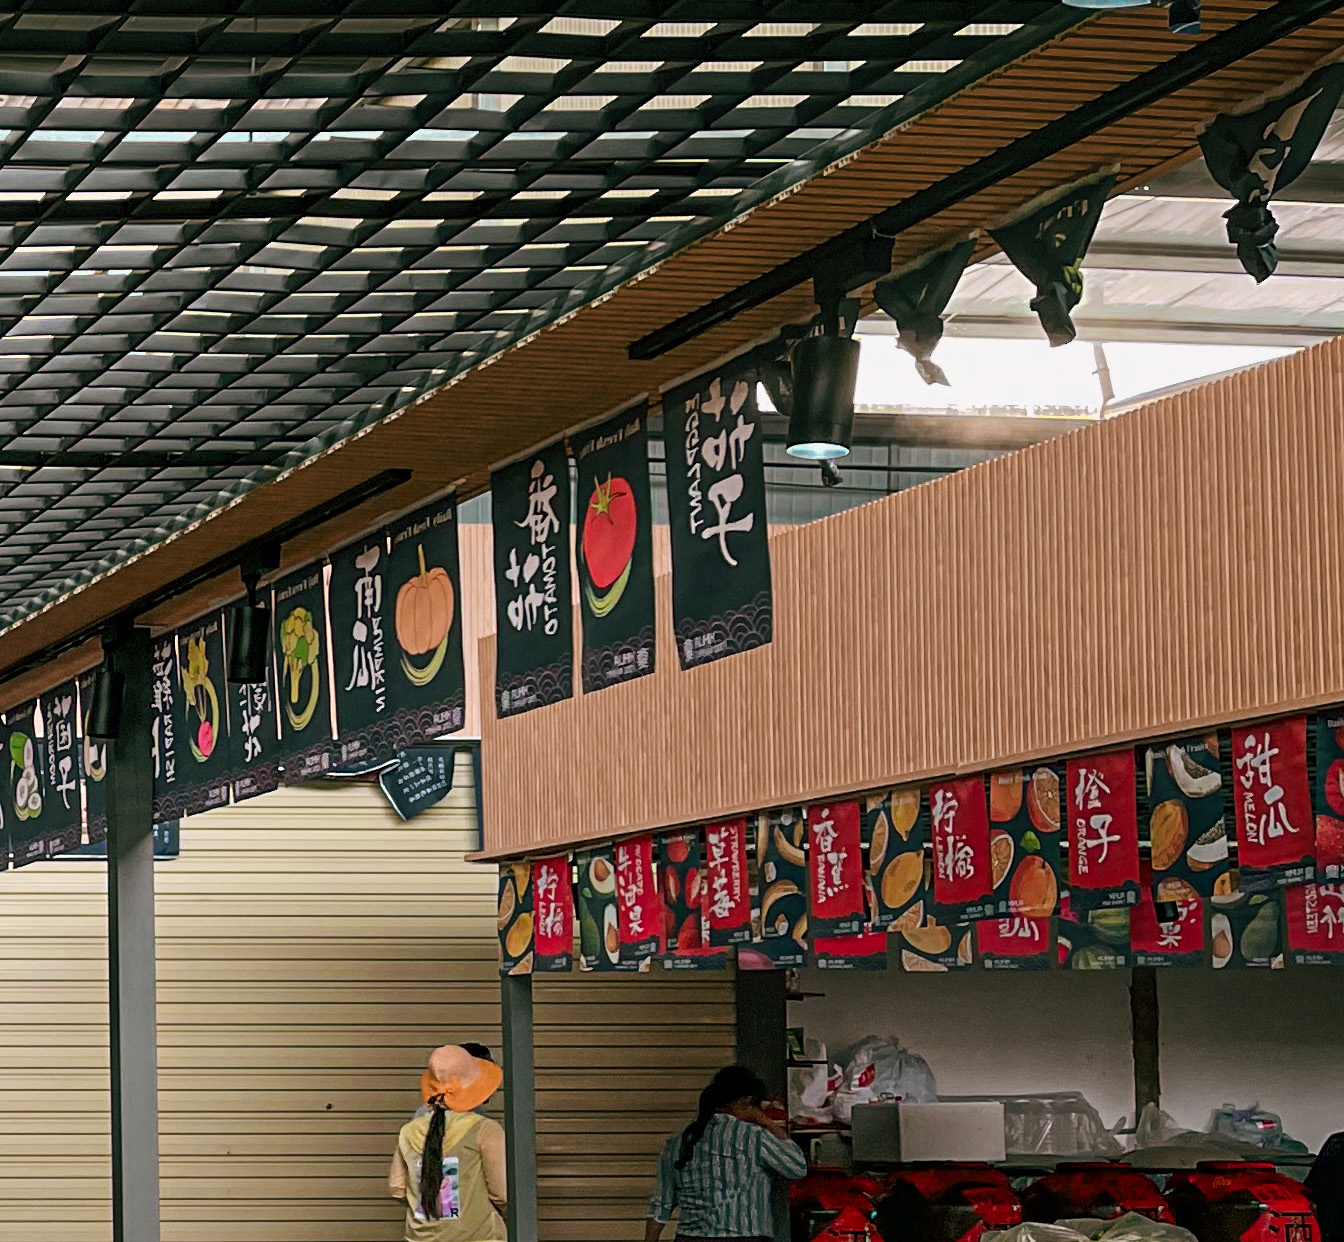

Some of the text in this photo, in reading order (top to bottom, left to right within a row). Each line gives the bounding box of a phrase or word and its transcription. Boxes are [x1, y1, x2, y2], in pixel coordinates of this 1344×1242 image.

[1075, 769, 1121, 864] 橙子
[1236, 733, 1300, 845] 甜瓜
[1243, 791, 1258, 843] MELON
[635, 844, 644, 895] AVOCADO
[708, 827, 736, 918] 草莓
[814, 808, 849, 897] 香蕉
[936, 836, 946, 879] LEMON
[1076, 818, 1089, 875] ORANGE
[817, 855, 826, 903] BANANA
